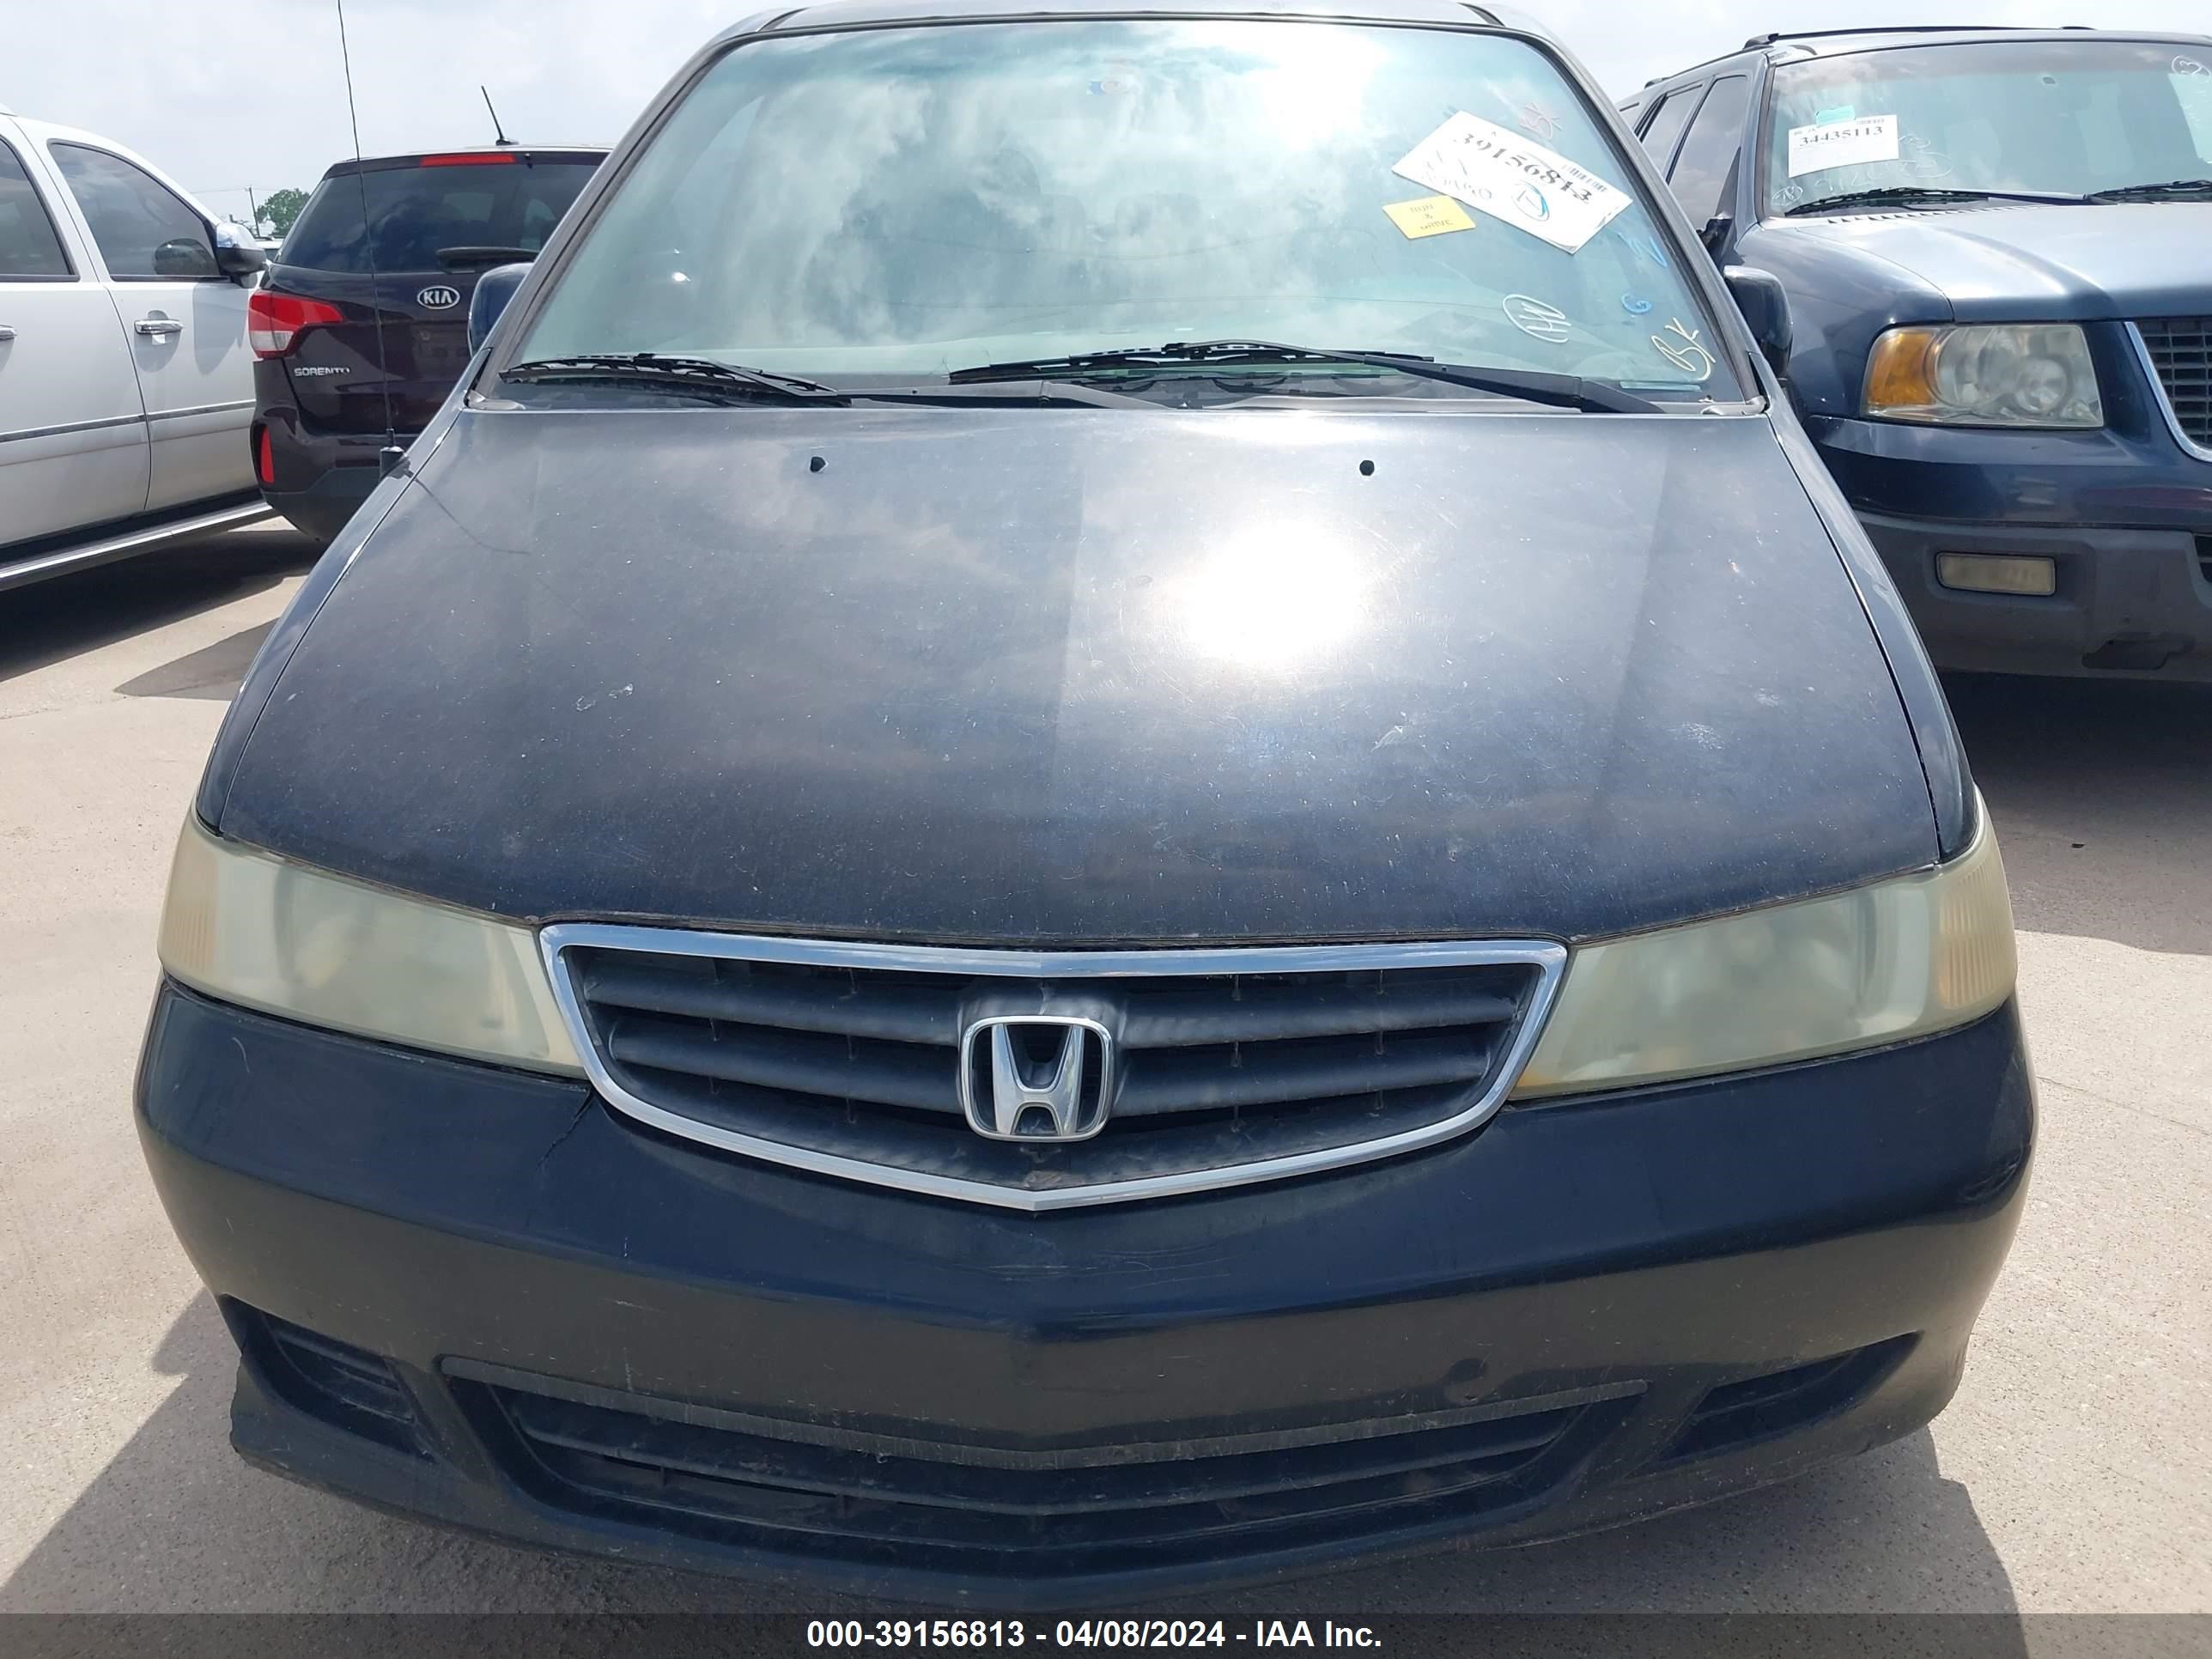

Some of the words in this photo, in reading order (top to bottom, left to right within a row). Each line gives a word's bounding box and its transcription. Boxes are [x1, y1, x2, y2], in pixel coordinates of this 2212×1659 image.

[1799, 126, 1883, 148] 34435113
[1452, 131, 1594, 205] 39156813
[423, 290, 453, 304] KIA
